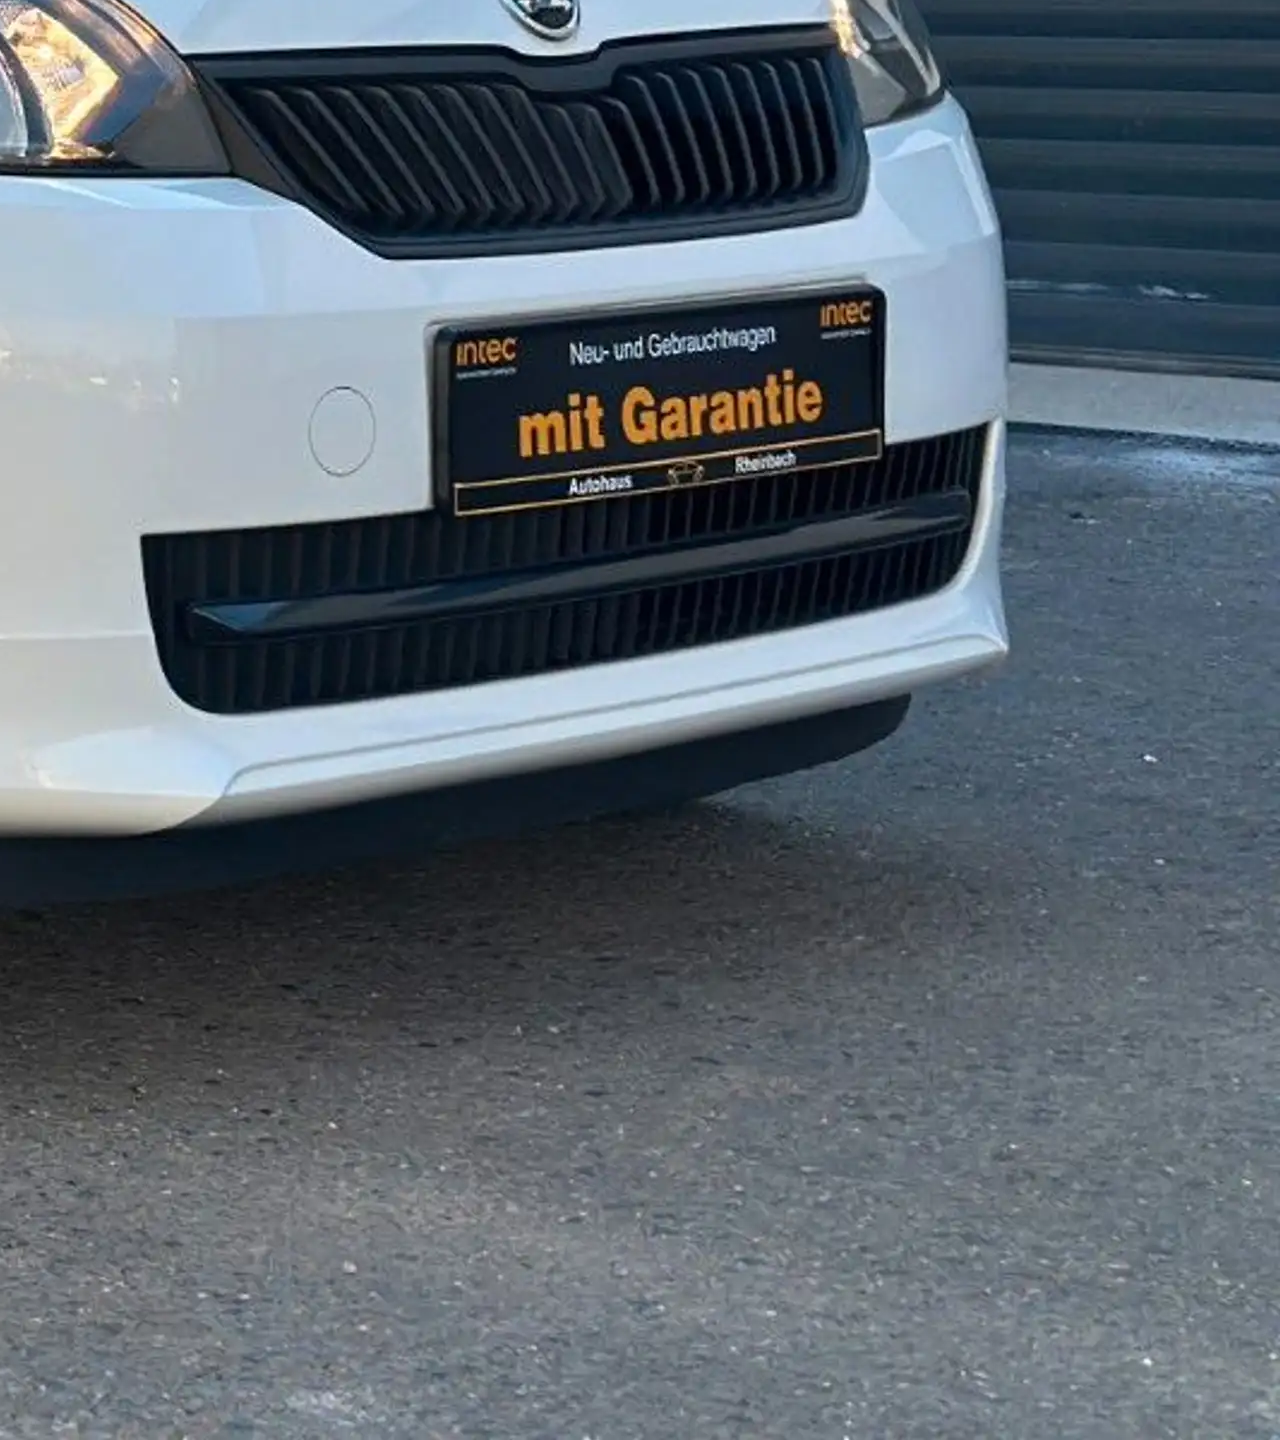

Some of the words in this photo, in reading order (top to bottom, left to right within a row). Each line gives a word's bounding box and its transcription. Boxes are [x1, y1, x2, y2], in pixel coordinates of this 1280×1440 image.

[569, 340, 610, 366] Neu-
[613, 336, 643, 361] und
[648, 326, 776, 357] Gebrauchtwagen
[519, 393, 605, 457] mit
[622, 368, 823, 444] Garantie
[568, 474, 634, 496] Autohaus
[735, 449, 797, 474] Rheinbach
